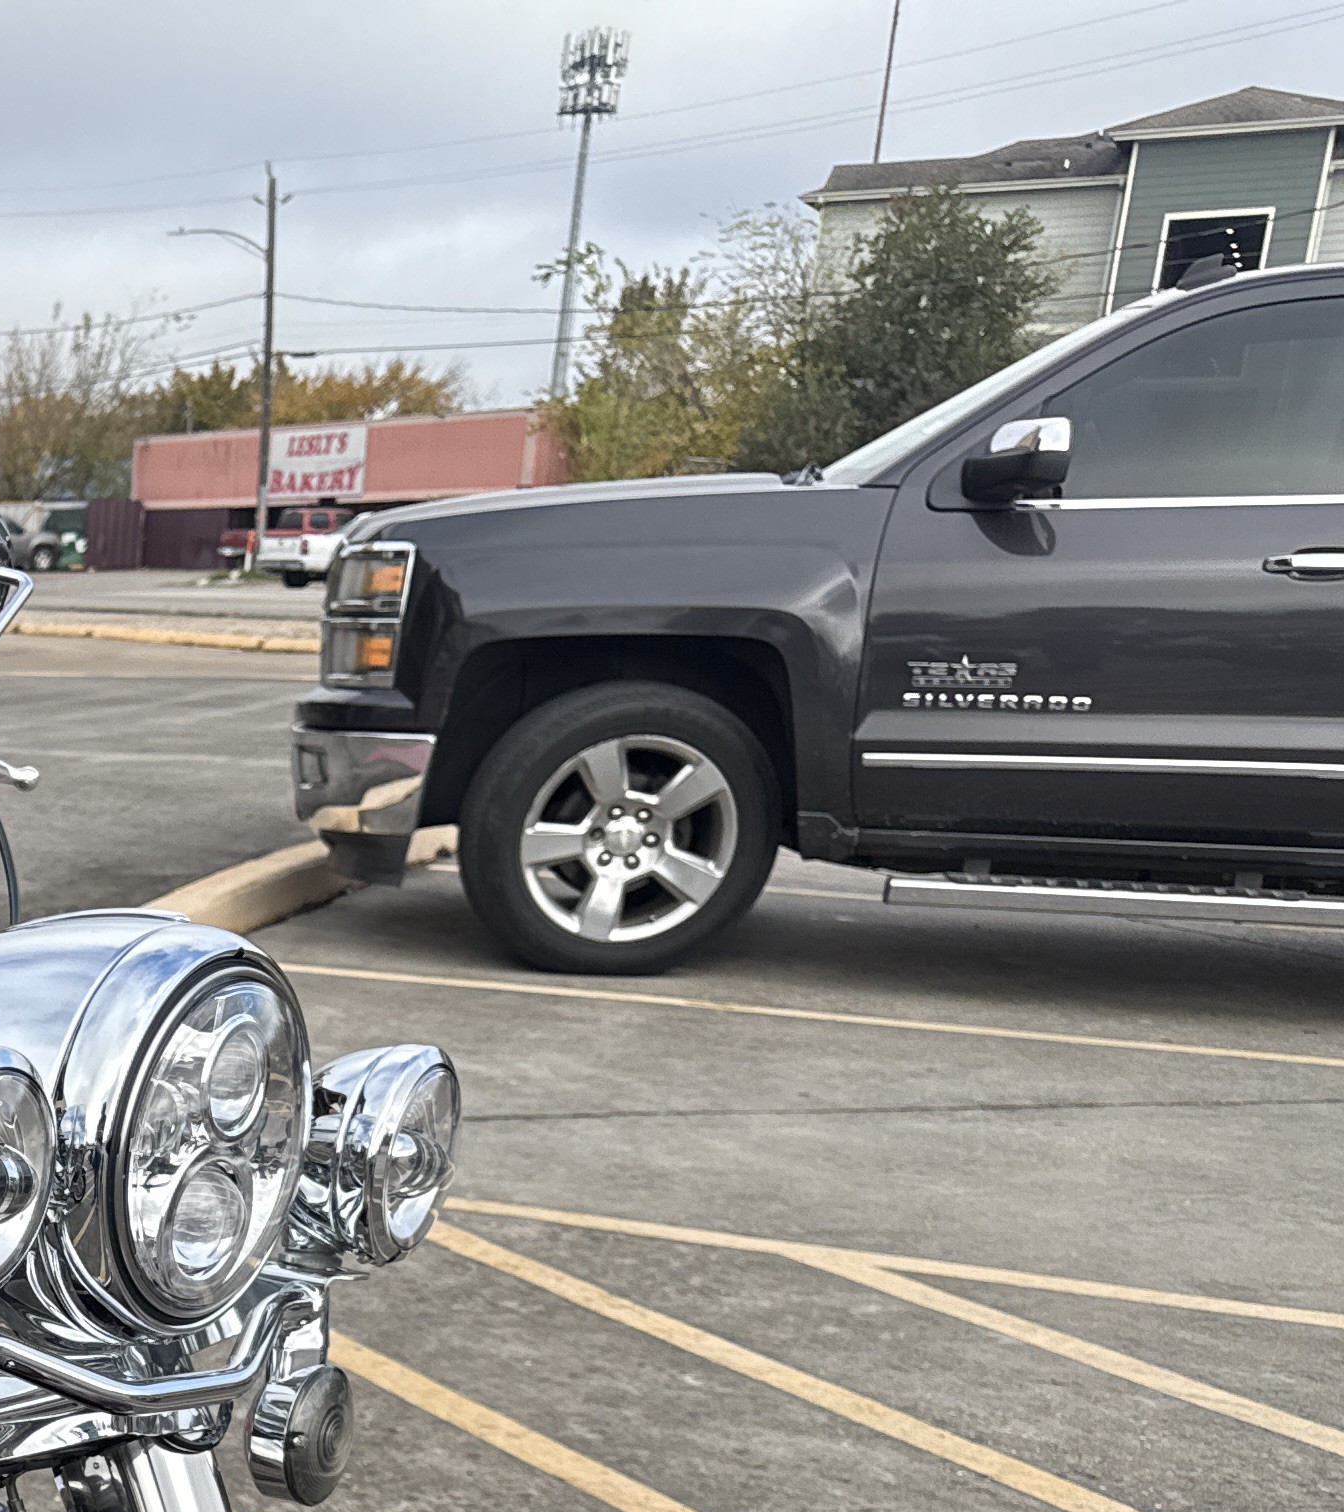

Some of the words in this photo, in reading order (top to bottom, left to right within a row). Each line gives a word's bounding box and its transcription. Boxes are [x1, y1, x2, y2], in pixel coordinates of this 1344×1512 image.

[287, 431, 348, 458] LESLY'S
[268, 461, 365, 494] BAKERY
[906, 656, 1019, 680] TEXAS
[902, 691, 1092, 712] SILVERADO
